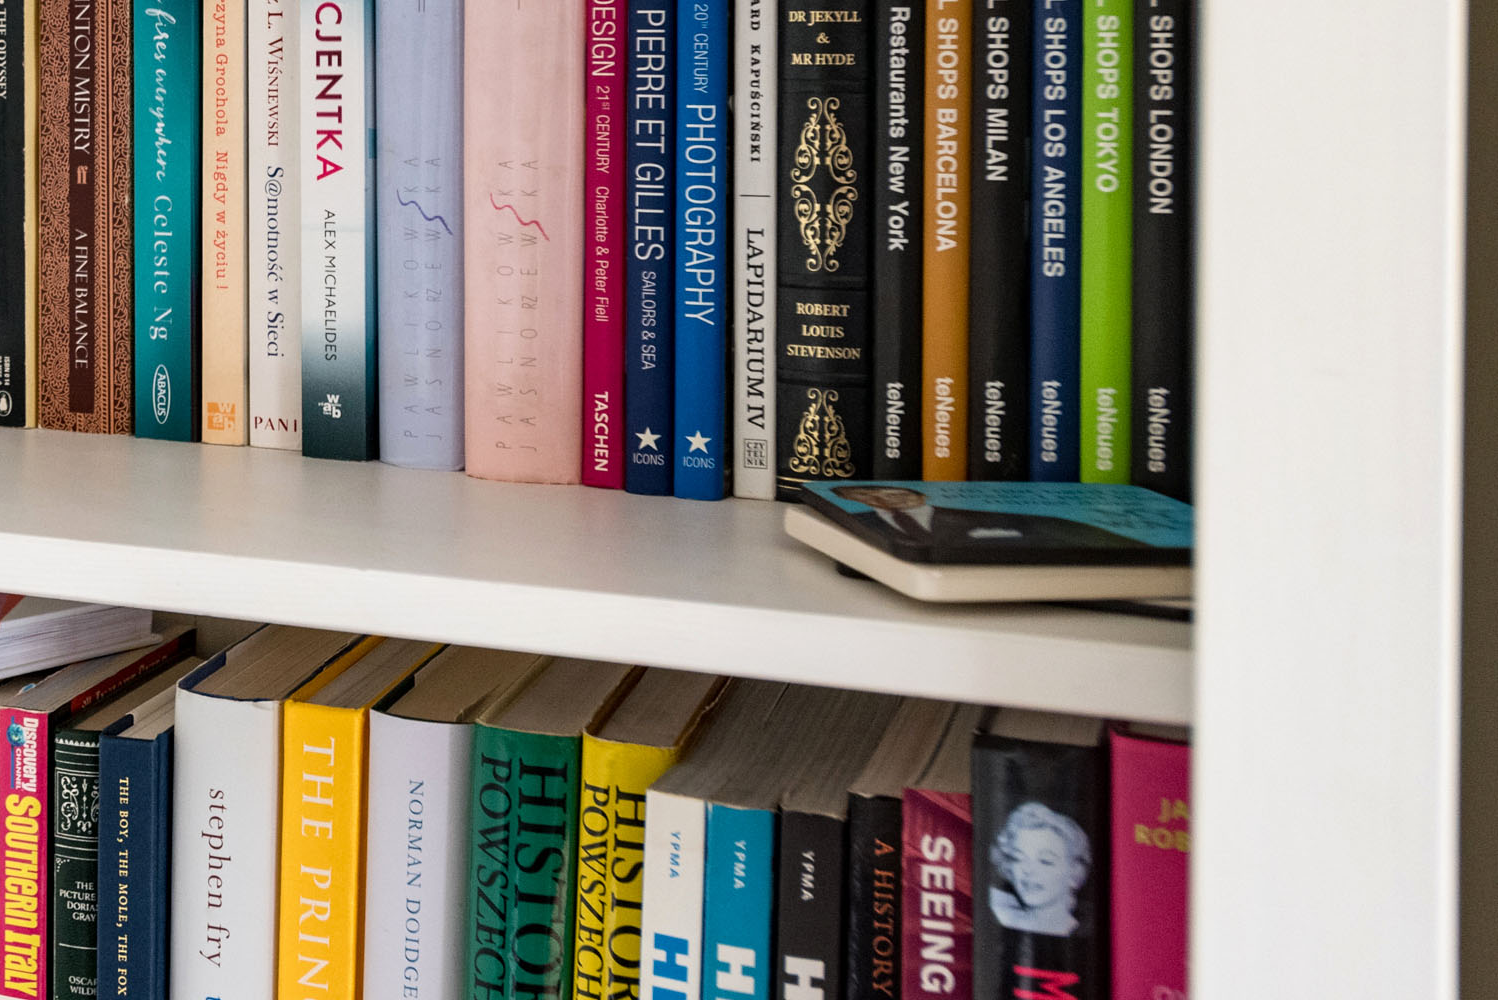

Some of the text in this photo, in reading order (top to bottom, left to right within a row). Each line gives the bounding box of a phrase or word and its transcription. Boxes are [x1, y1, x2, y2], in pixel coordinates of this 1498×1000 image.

[145, 8, 176, 62] fires
[788, 11, 861, 27] DR JEKYLL
[792, 54, 855, 65] MR HYDE
[1150, 15, 1174, 101] SHOPS
[215, 53, 229, 137] Grochola
[267, 36, 284, 147] WIŚNIEWSKI
[750, 45, 761, 163] KAPUŚCIŃSKI
[890, 7, 911, 138] Restaurants
[74, 77, 90, 154] MISTRY
[149, 68, 172, 182] everywhere
[595, 114, 610, 174] CENTURY
[214, 152, 228, 204] Nigdy
[634, 9, 666, 370] PIERRE ET GILLES SAILORS SEA
[685, 33, 717, 326] CENTURY PHOTOGRAPHY
[888, 146, 910, 194] New
[1149, 110, 1174, 215] LONDON
[153, 196, 173, 294] Celeste
[214, 230, 228, 278] życiu
[265, 166, 284, 281] S@motność
[595, 186, 609, 243] Charlotte
[887, 202, 910, 251] York
[75, 245, 88, 368] FINE BALANCE
[324, 209, 338, 361] ALEX MICHAELIDES
[595, 258, 609, 294] Peter
[595, 296, 609, 322] Fiell
[796, 303, 849, 317] ROBERT
[150, 307, 173, 340] Ng
[267, 310, 285, 357] Sieci
[747, 228, 765, 429] LAPIDARIUM IV
[787, 344, 861, 359] STEVENSON
[802, 325, 844, 338] LOUIS
[594, 391, 609, 472] TASCHEN
[198, 788, 231, 969] stephen fry
[403, 779, 424, 999] NORMAN DOIDGE
[670, 831, 681, 878] YPMA
[116, 809, 129, 996] BOY, MOLE, FOX
[872, 868, 895, 997] HISTORY
[920, 835, 955, 994] SEEING
